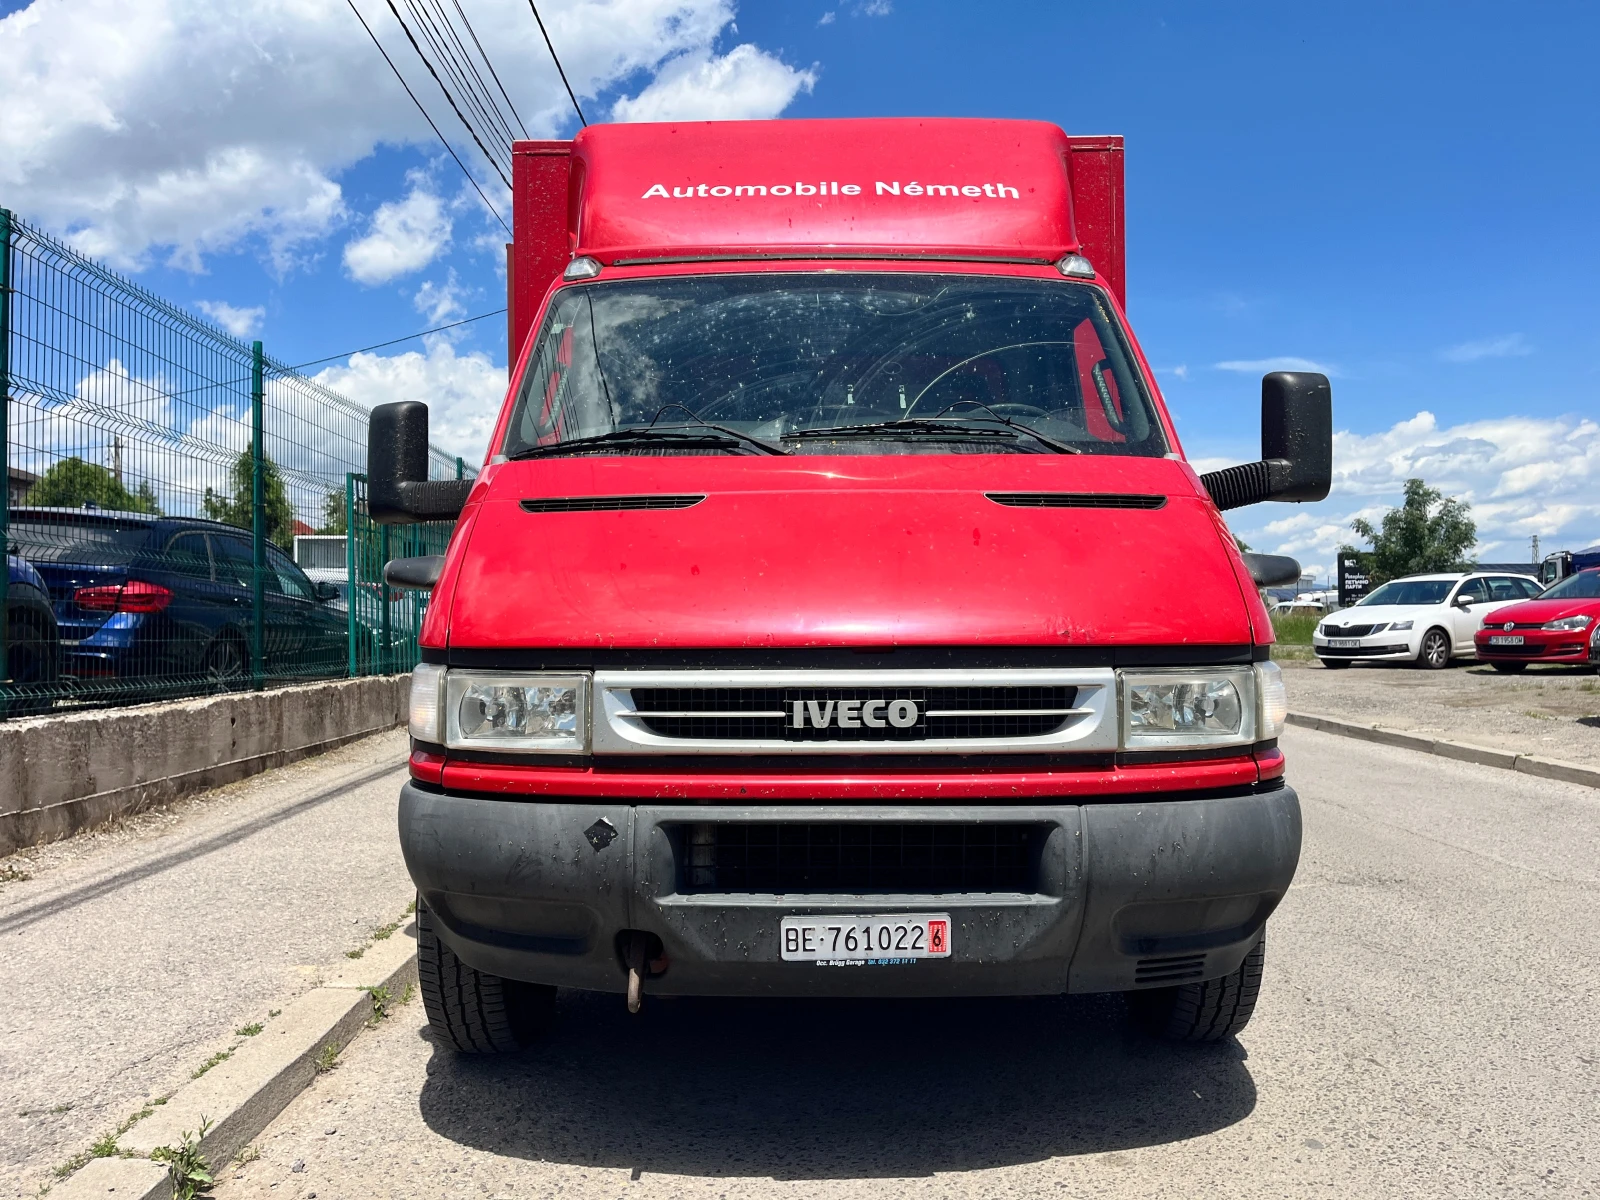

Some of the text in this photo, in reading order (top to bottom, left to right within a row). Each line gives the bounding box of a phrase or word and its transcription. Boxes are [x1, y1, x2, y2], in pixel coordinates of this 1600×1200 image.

[641, 181, 1020, 200] Automobile Németh
[793, 699, 918, 729] IVECO
[932, 929, 942, 947] 6
